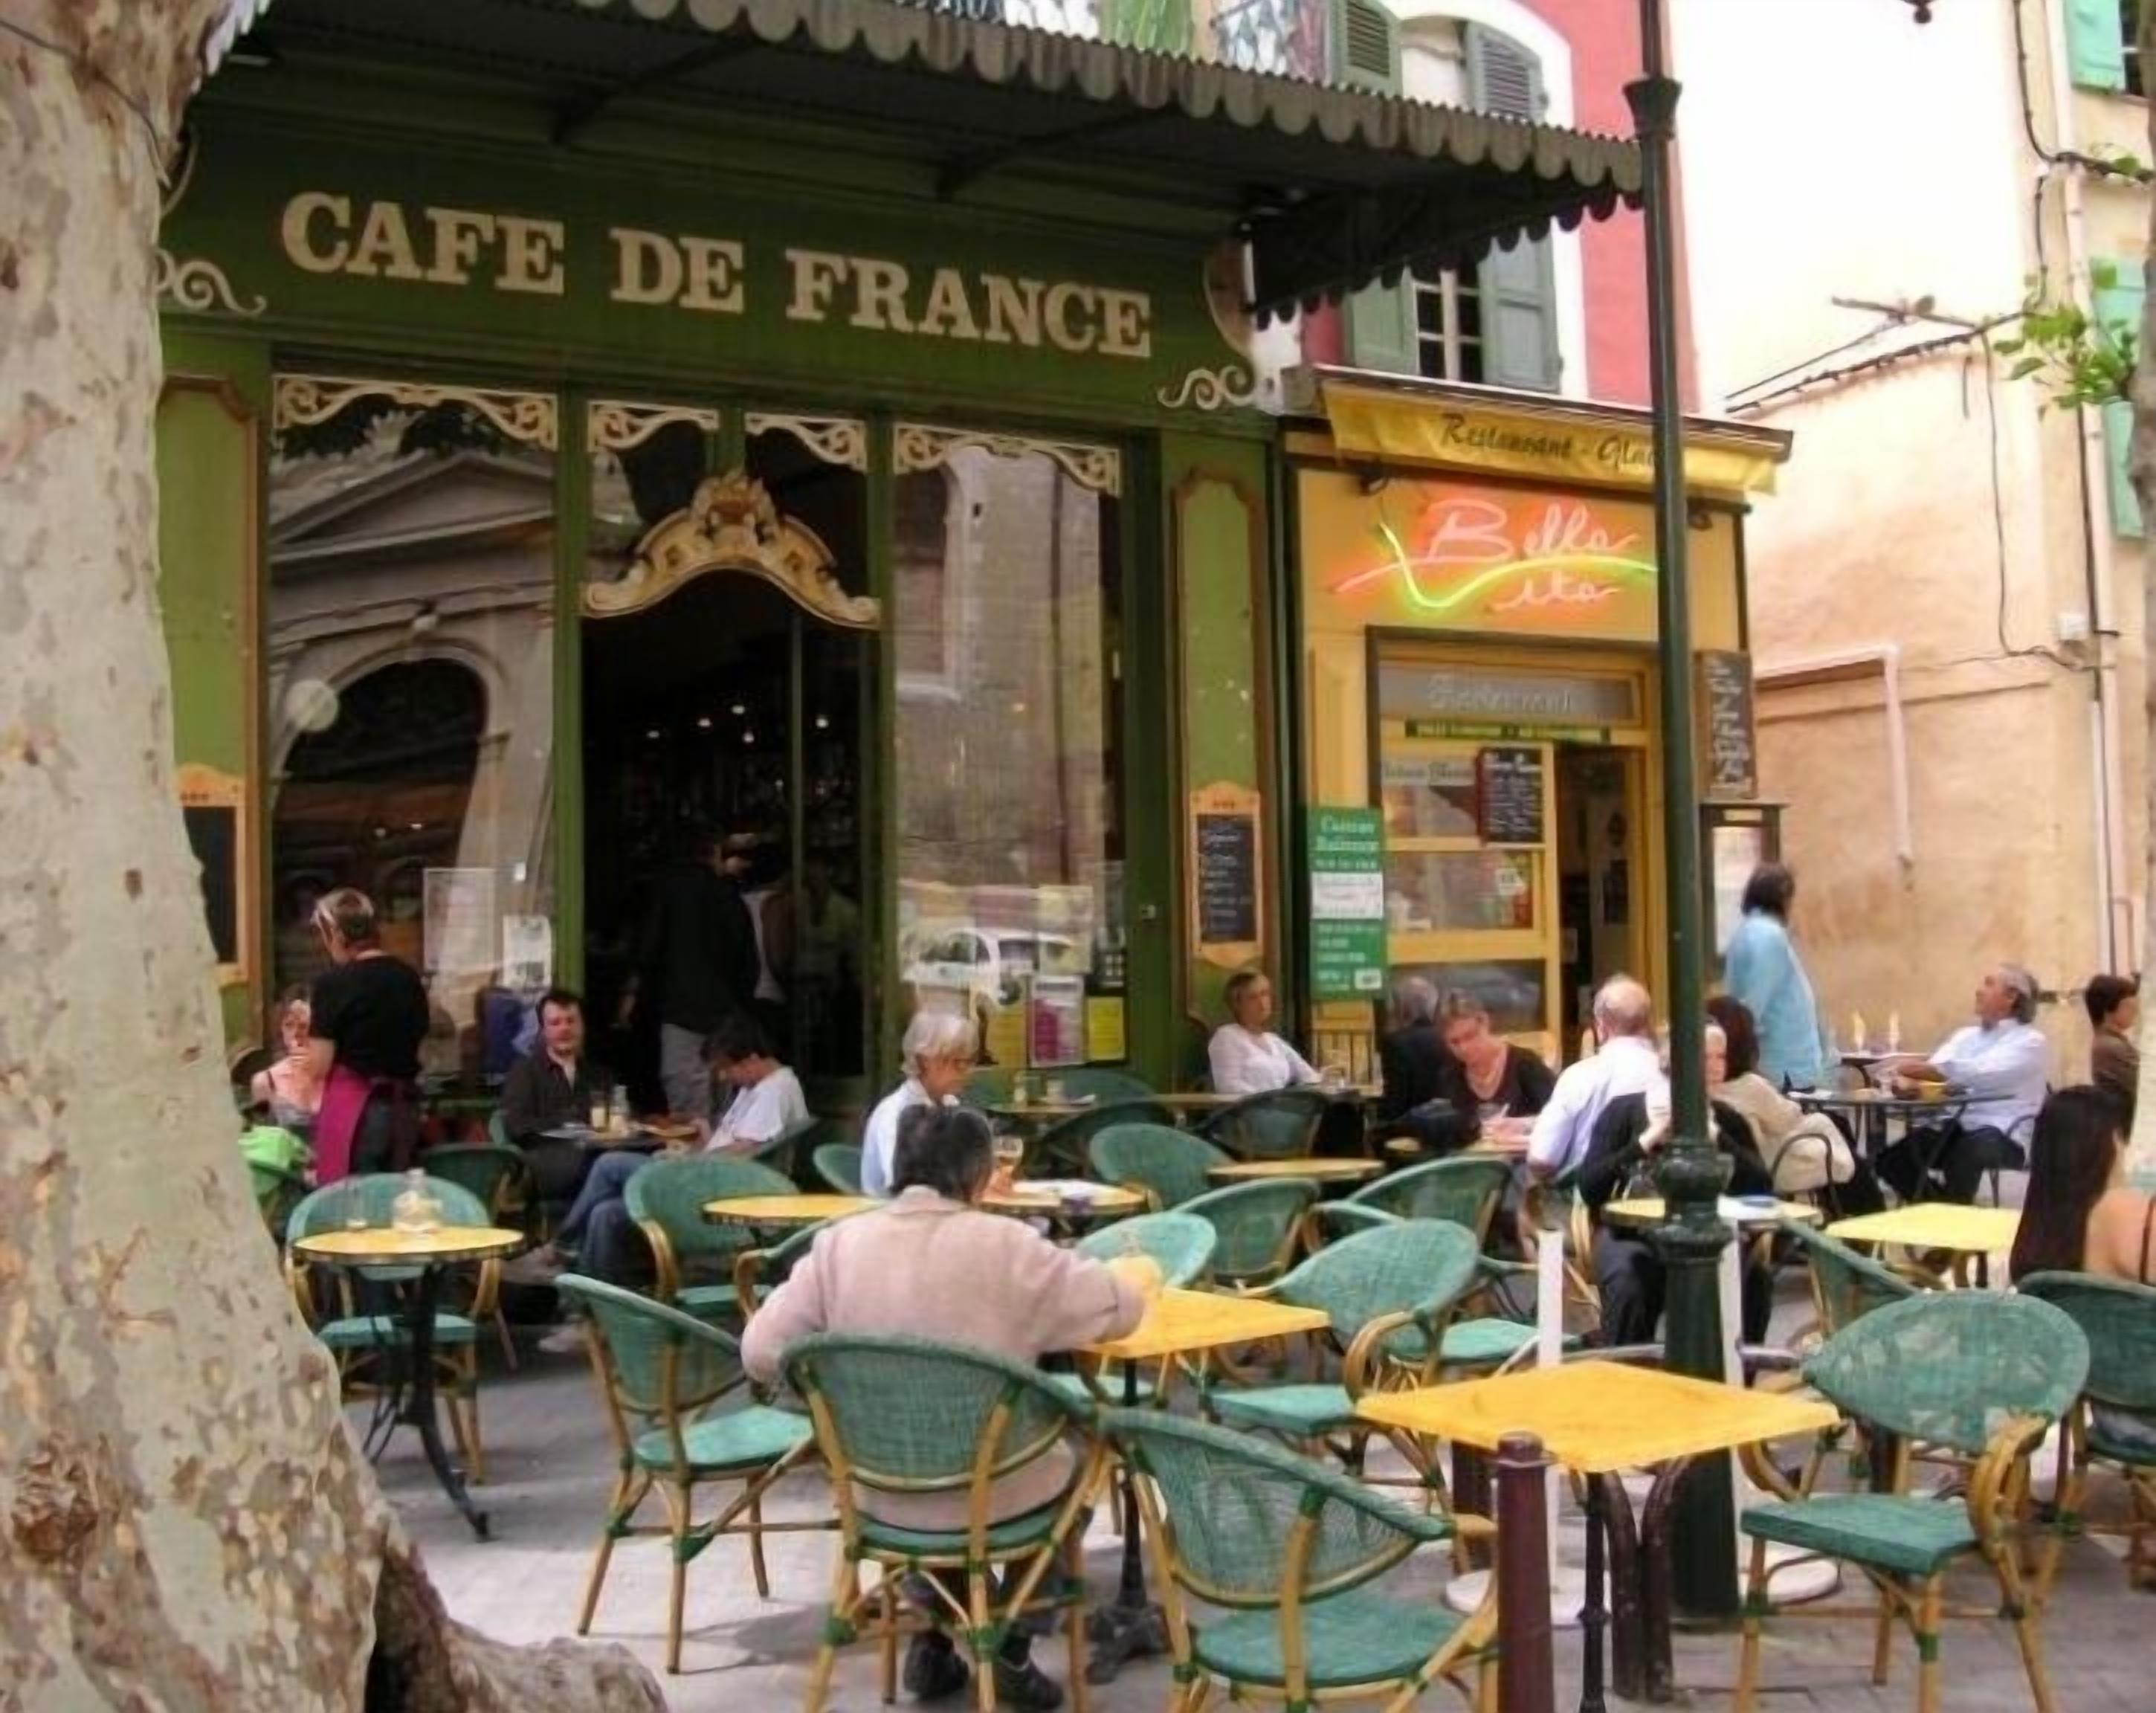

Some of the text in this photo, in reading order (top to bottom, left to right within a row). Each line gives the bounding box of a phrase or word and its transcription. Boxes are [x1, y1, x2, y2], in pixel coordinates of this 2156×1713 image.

[282, 192, 1152, 358] CAFE DE FRANCE
